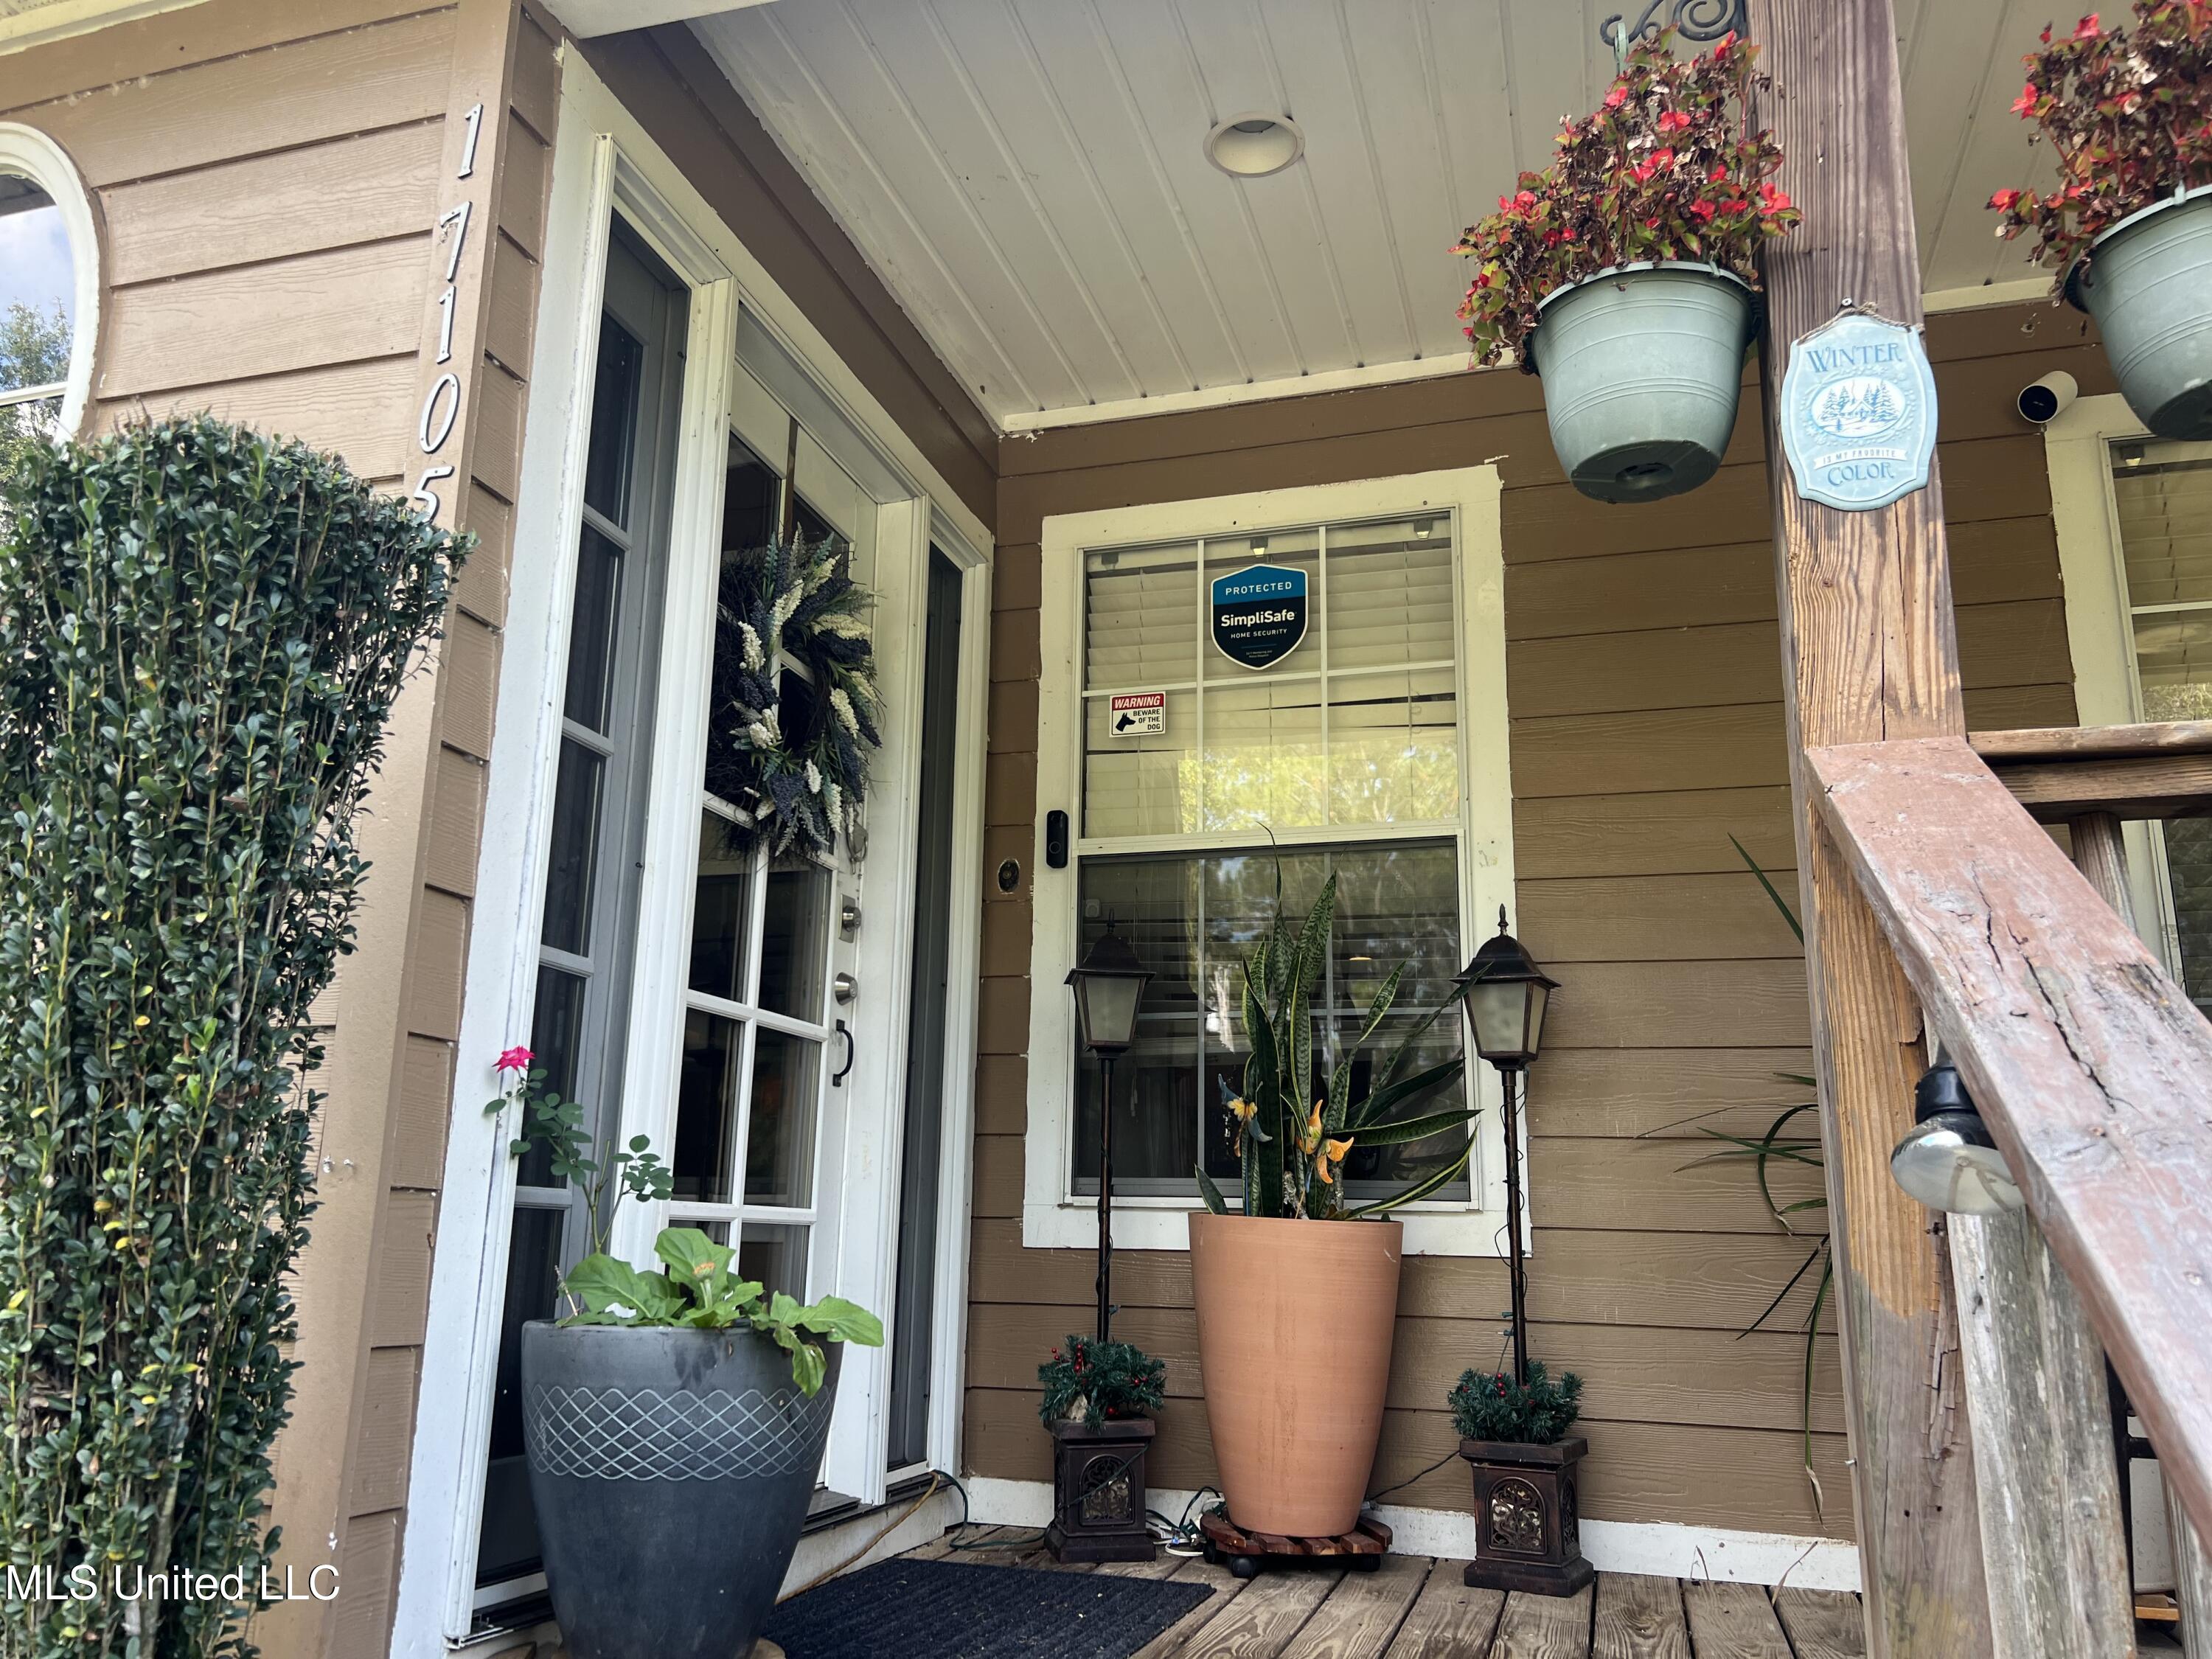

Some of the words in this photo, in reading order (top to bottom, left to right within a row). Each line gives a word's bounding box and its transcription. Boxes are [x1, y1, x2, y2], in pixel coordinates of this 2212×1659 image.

[413, 102, 484, 524] 17105
[1806, 342, 1903, 372] WINTER
[1823, 456, 1832, 465] IS
[1836, 452, 1848, 460] MY
[1852, 449, 1896, 458] FAVORITE
[1827, 462, 1894, 486] COLOR
[1225, 581, 1293, 596] PROTECTED
[1221, 609, 1295, 627] SimpliSafe
[1231, 631, 1251, 639] HOME
[1253, 628, 1287, 637] SECURITY
[1115, 695, 1161, 709] WARNING
[1133, 709, 1161, 717] BEWARE
